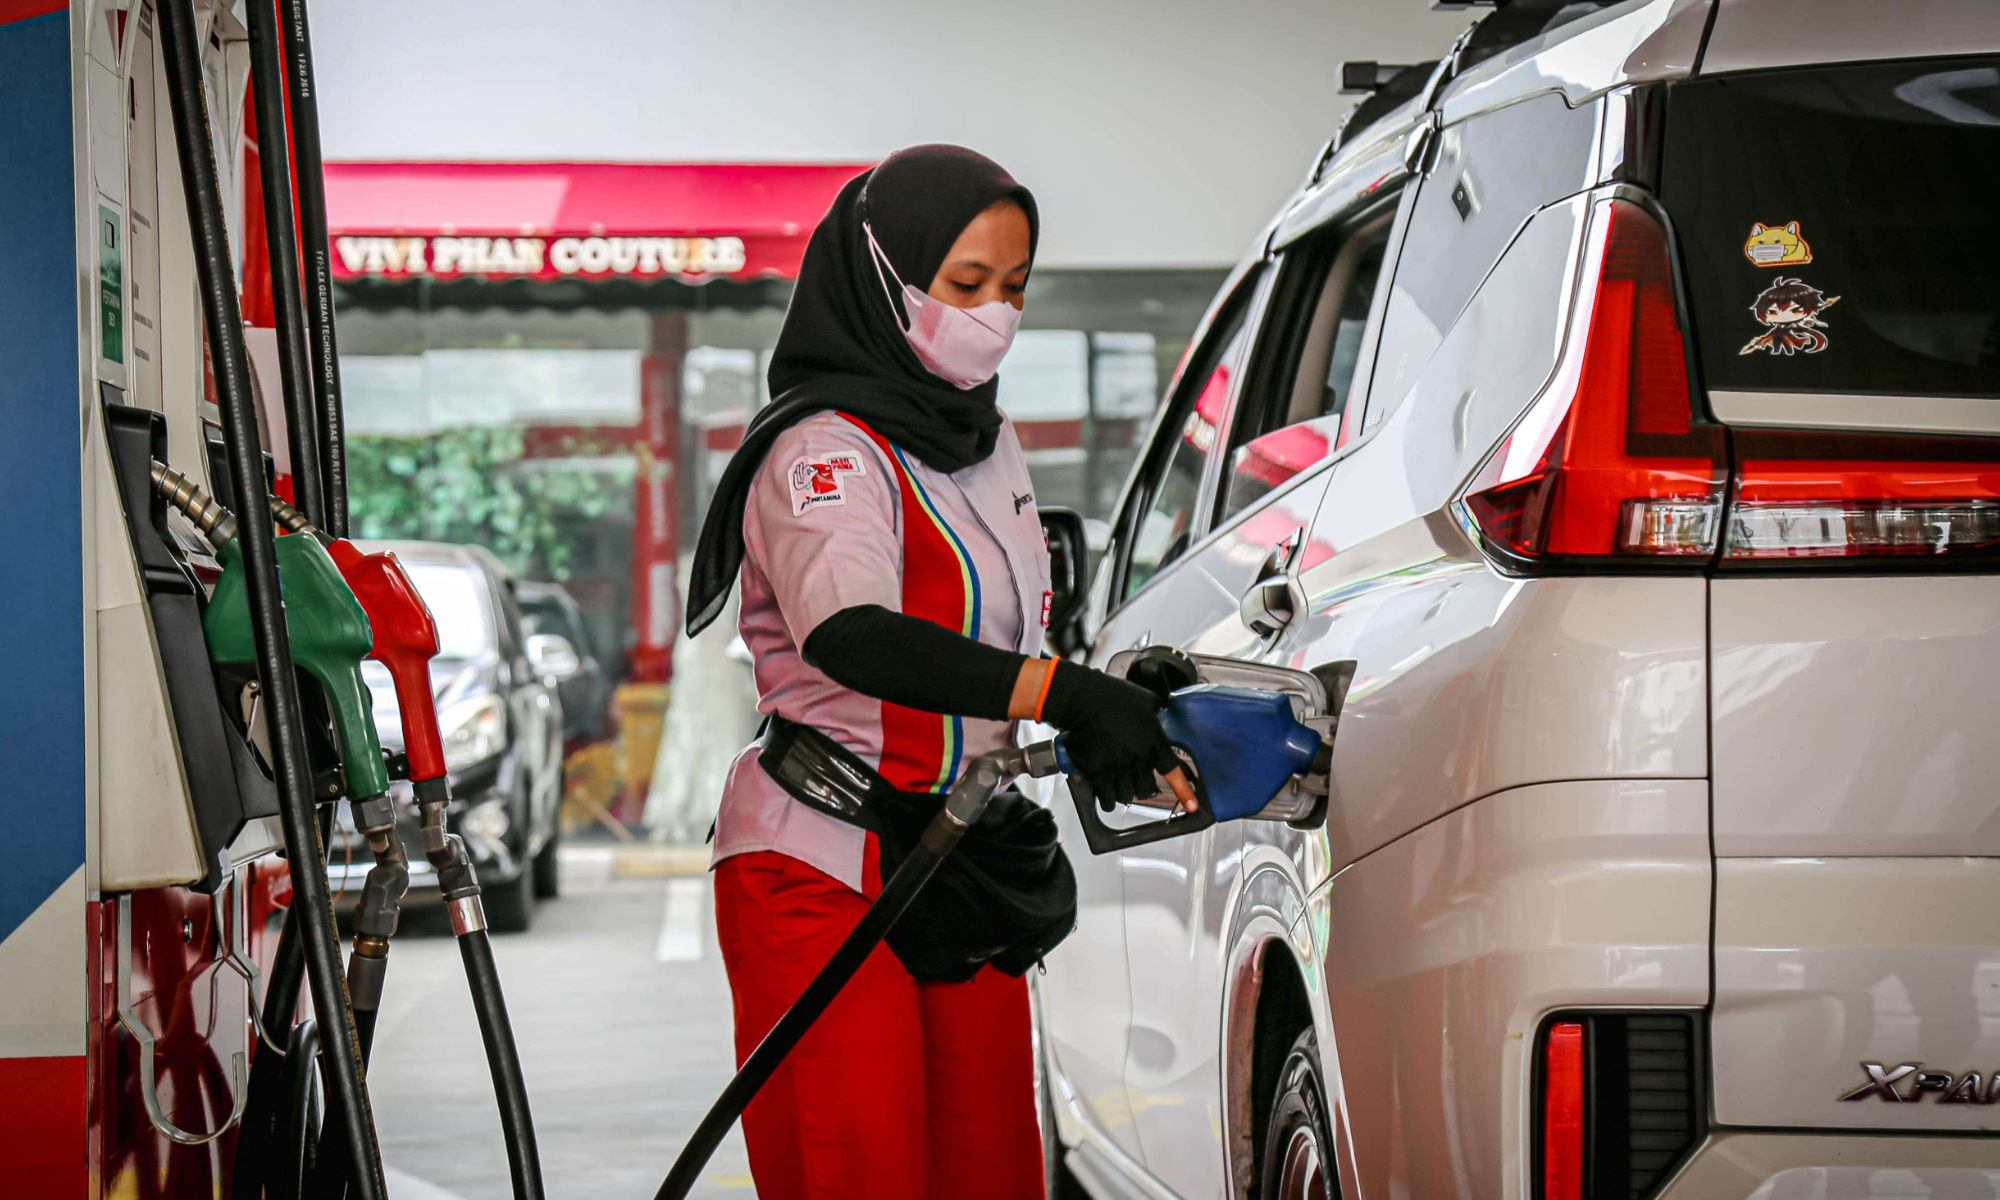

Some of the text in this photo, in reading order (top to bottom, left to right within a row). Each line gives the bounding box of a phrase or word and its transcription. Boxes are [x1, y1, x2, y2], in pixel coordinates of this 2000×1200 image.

[337, 236, 747, 274] VIVI PHAN COUTURE
[318, 284, 329, 322] GERMAN
[321, 323, 335, 384] TECHNOLOGY
[329, 424, 338, 442] SAE
[331, 444, 340, 460] 100
[811, 494, 841, 503] PERTAMINA
